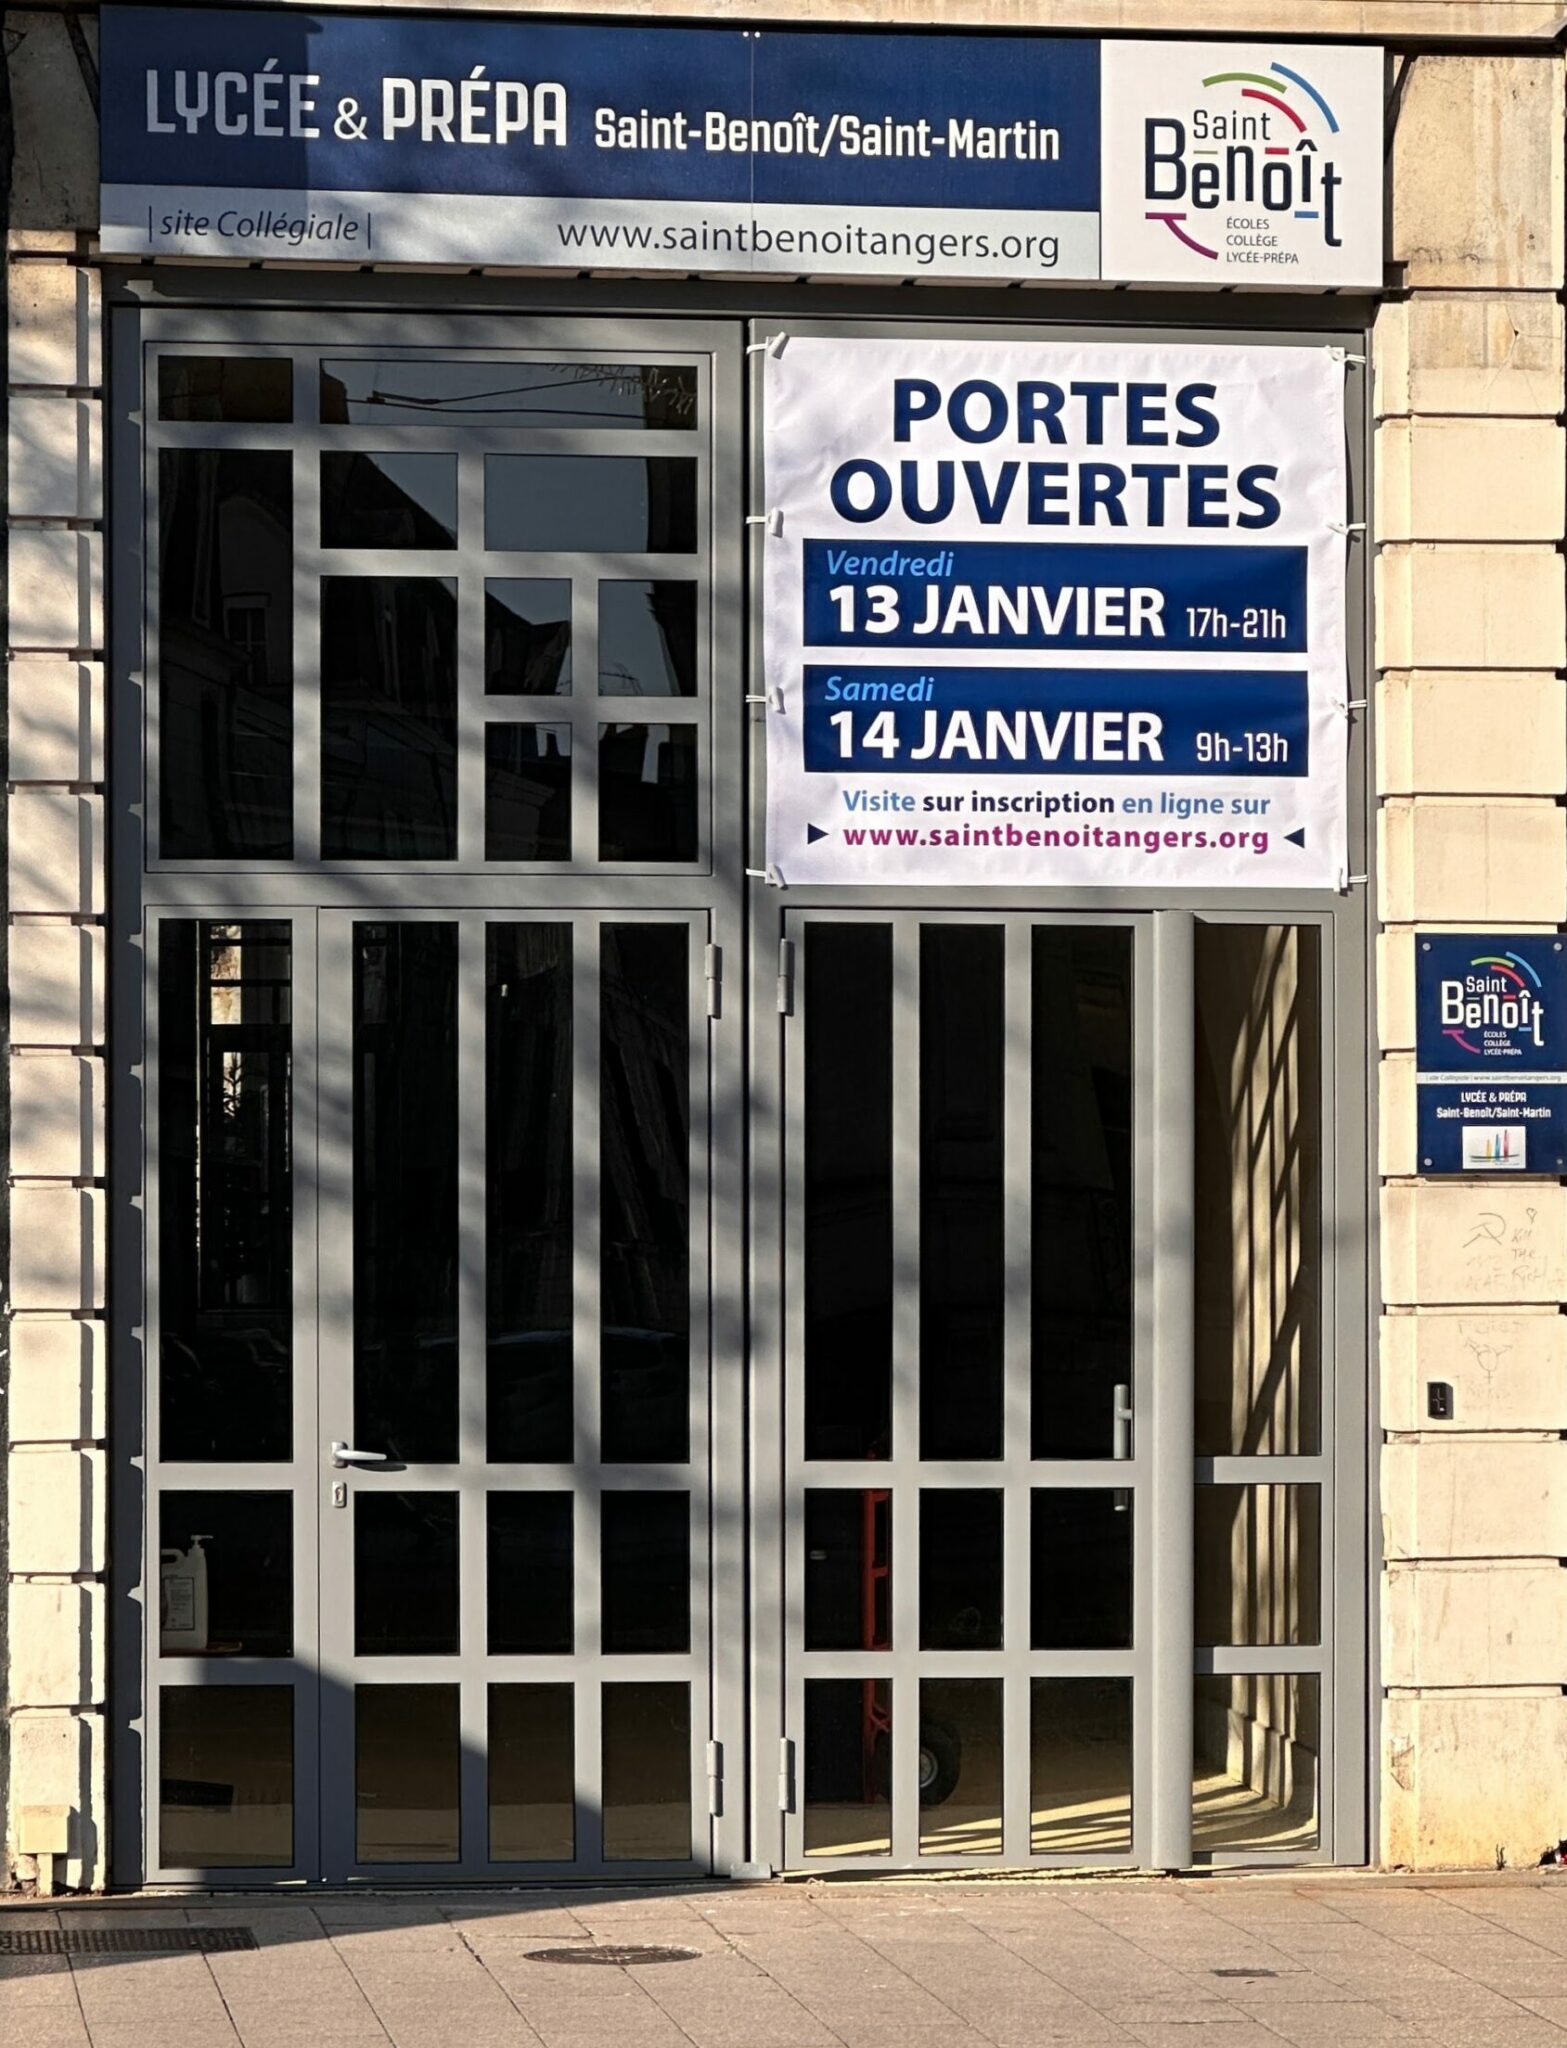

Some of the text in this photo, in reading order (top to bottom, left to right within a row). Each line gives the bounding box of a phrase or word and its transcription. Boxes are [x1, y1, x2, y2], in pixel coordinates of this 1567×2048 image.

[146, 57, 1059, 160] LYCÉE & PRÉPA Saint-Benoît/Saint-Martin
[1194, 110, 1270, 140] Saint
[1144, 117, 1342, 247] Benoît
[217, 210, 360, 244] Collégiale
[1227, 216, 1269, 229] ÉCOLES
[558, 220, 1060, 267] www.saintbenoitangers.org
[1226, 234, 1277, 246] COLLÈGE
[1227, 251, 1299, 264] LYCÉE-PRÉPA
[894, 379, 1219, 447] PORTES
[830, 459, 1280, 529] OUVERTES
[828, 550, 954, 576] Vendredi
[830, 585, 1285, 638] 13 JANVIER 17h-21h
[825, 676, 934, 701] Samedi
[831, 710, 1287, 762] 14 JANVIER 9h-13h
[843, 790, 1270, 819] Visite sur inscription en ligne sur
[843, 823, 1268, 854] www.saintbenoitangers.org
[1467, 976, 1506, 992] Saint
[1441, 980, 1545, 1046] Benoît
[1489, 1092, 1497, 1102] &
